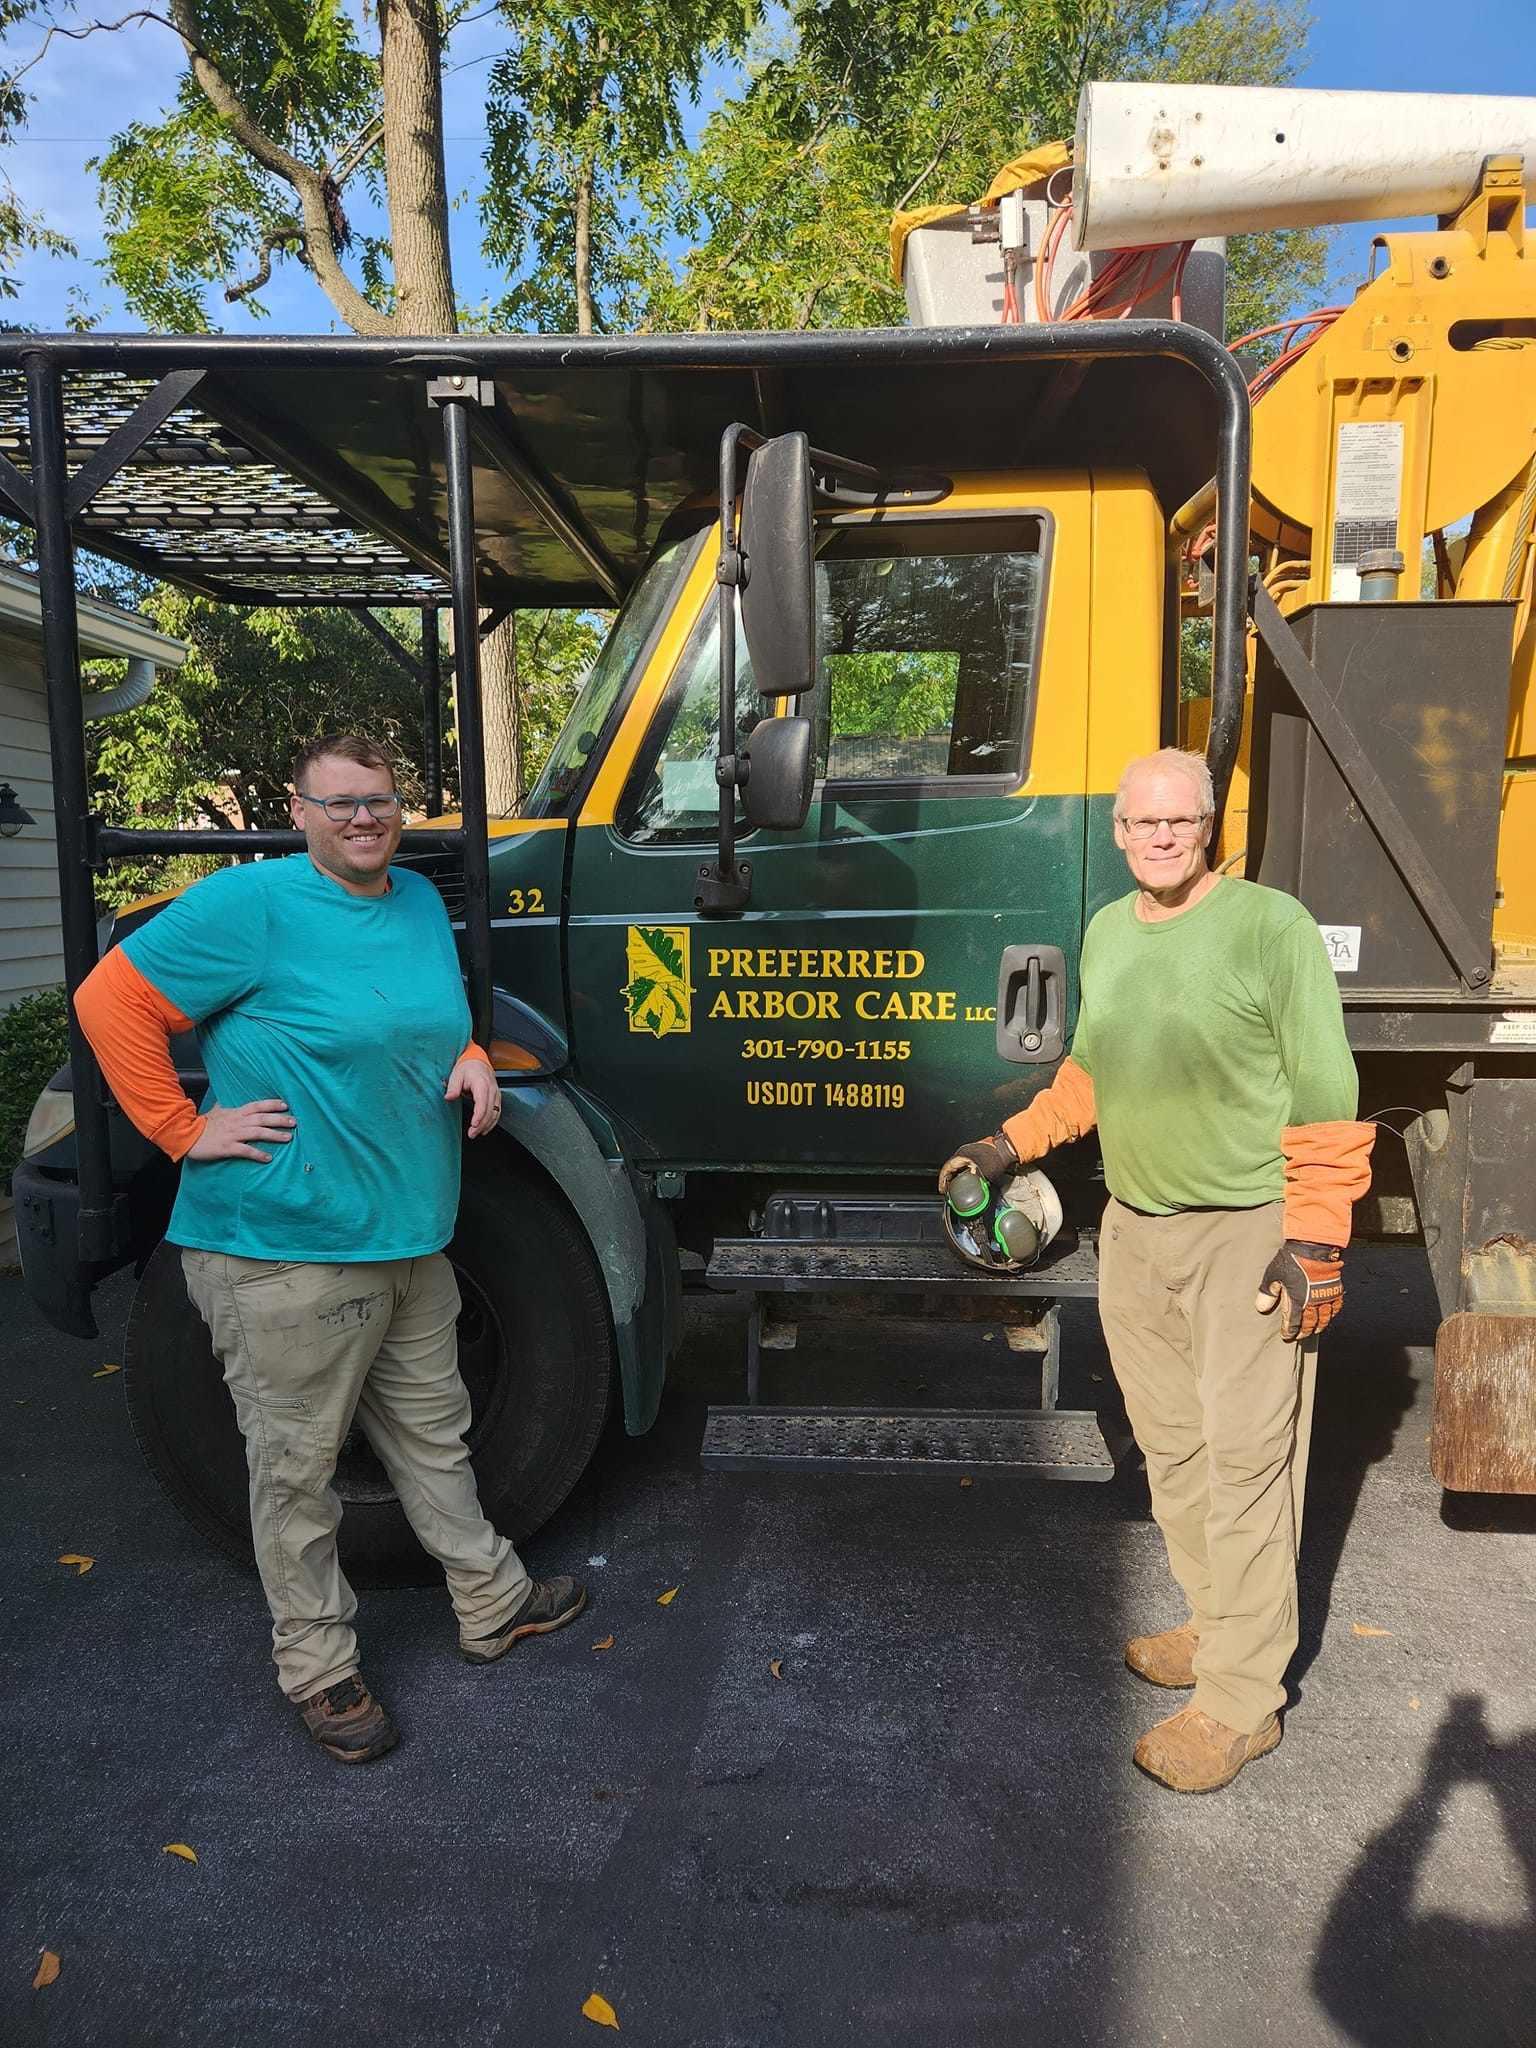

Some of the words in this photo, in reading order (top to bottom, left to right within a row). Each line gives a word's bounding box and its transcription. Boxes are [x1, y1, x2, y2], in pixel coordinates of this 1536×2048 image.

[507, 888, 545, 914] 32
[707, 948, 925, 979] PREFERRED
[708, 989, 842, 1021] ARBOR
[854, 990, 957, 1022] CARE
[964, 1006, 997, 1022] LLC
[1503, 1023, 1520, 1031] KEEP
[741, 1038, 912, 1061] 301-790-1155
[746, 1080, 817, 1107] USDOT
[824, 1082, 905, 1109] 1488119
